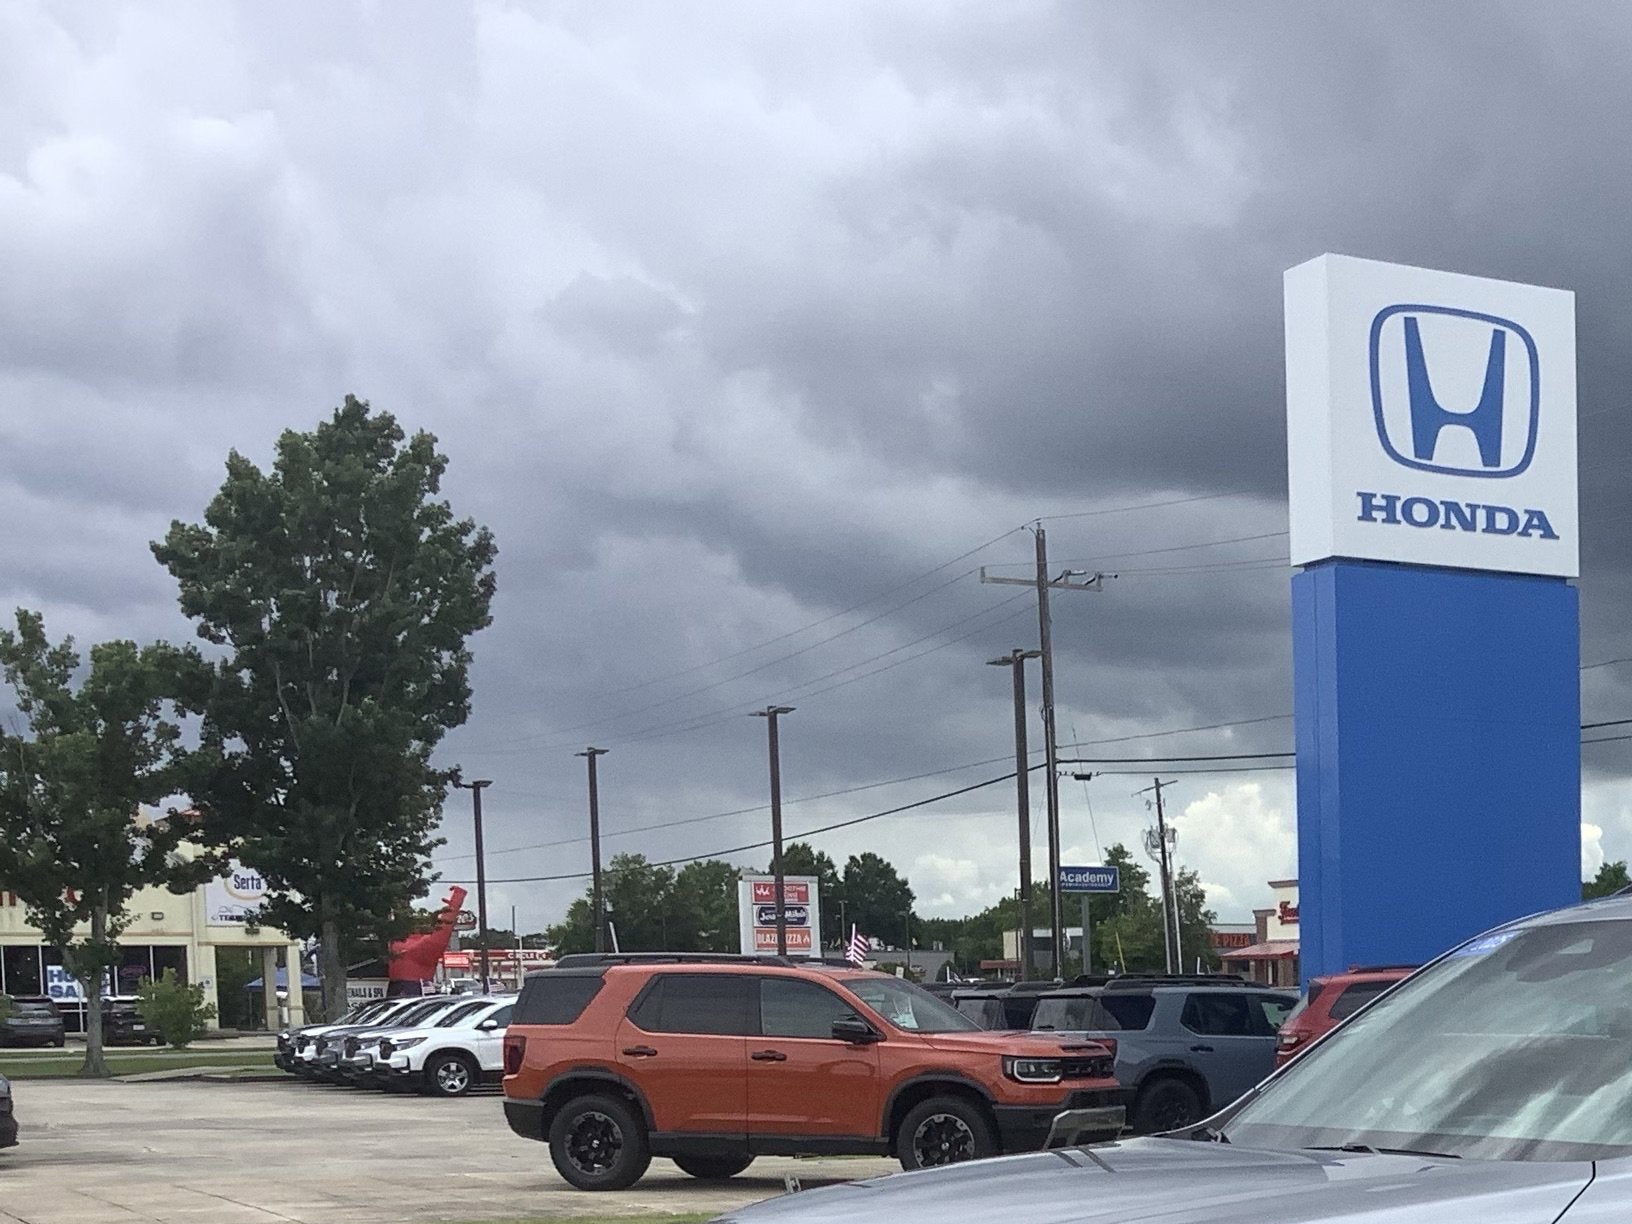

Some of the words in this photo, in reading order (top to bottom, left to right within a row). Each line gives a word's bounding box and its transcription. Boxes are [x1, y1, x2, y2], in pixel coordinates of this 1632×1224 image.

[1355, 491, 1560, 540] HONDA
[233, 873, 262, 890] Serta
[1059, 870, 1114, 886] Academy
